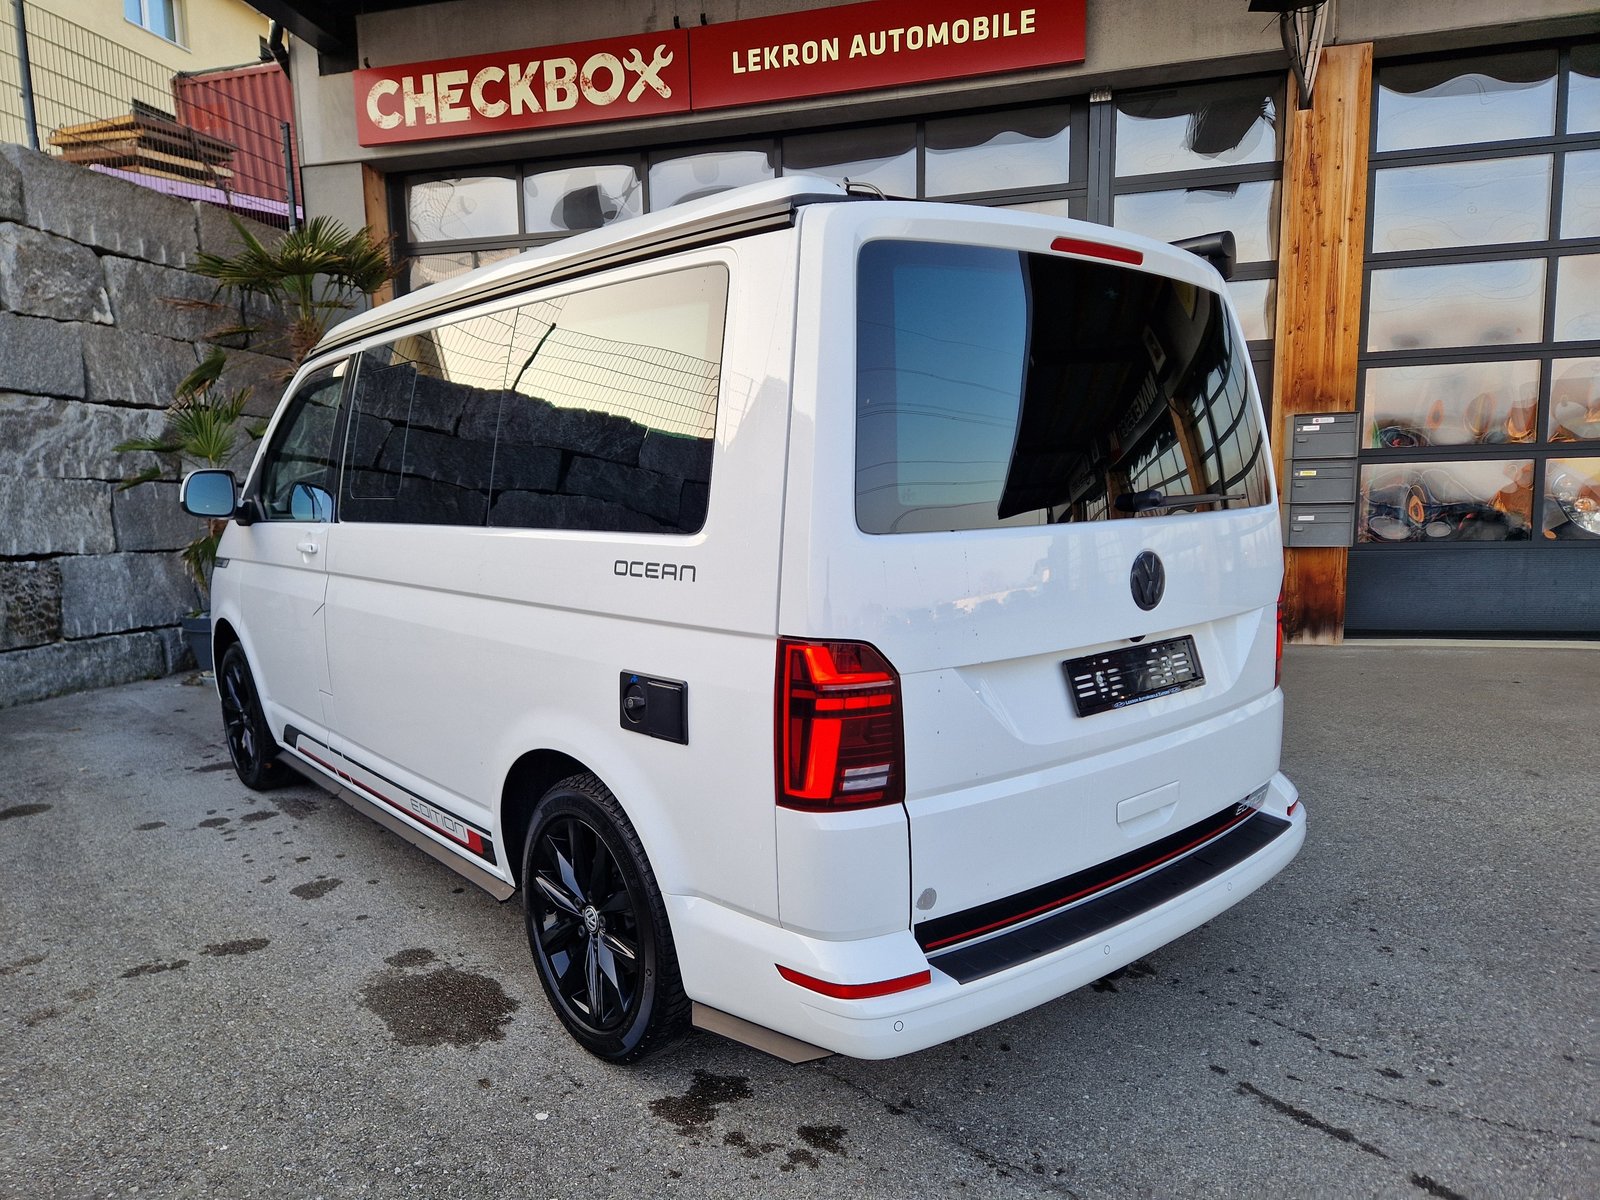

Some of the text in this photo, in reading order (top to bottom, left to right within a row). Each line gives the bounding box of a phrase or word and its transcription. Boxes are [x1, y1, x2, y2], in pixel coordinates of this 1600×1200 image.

[732, 8, 1036, 74] LEKRON AUTOMOBILE
[366, 44, 673, 130] CHECKBOX
[614, 560, 696, 582] OCEAN
[410, 798, 467, 839] EDITION
